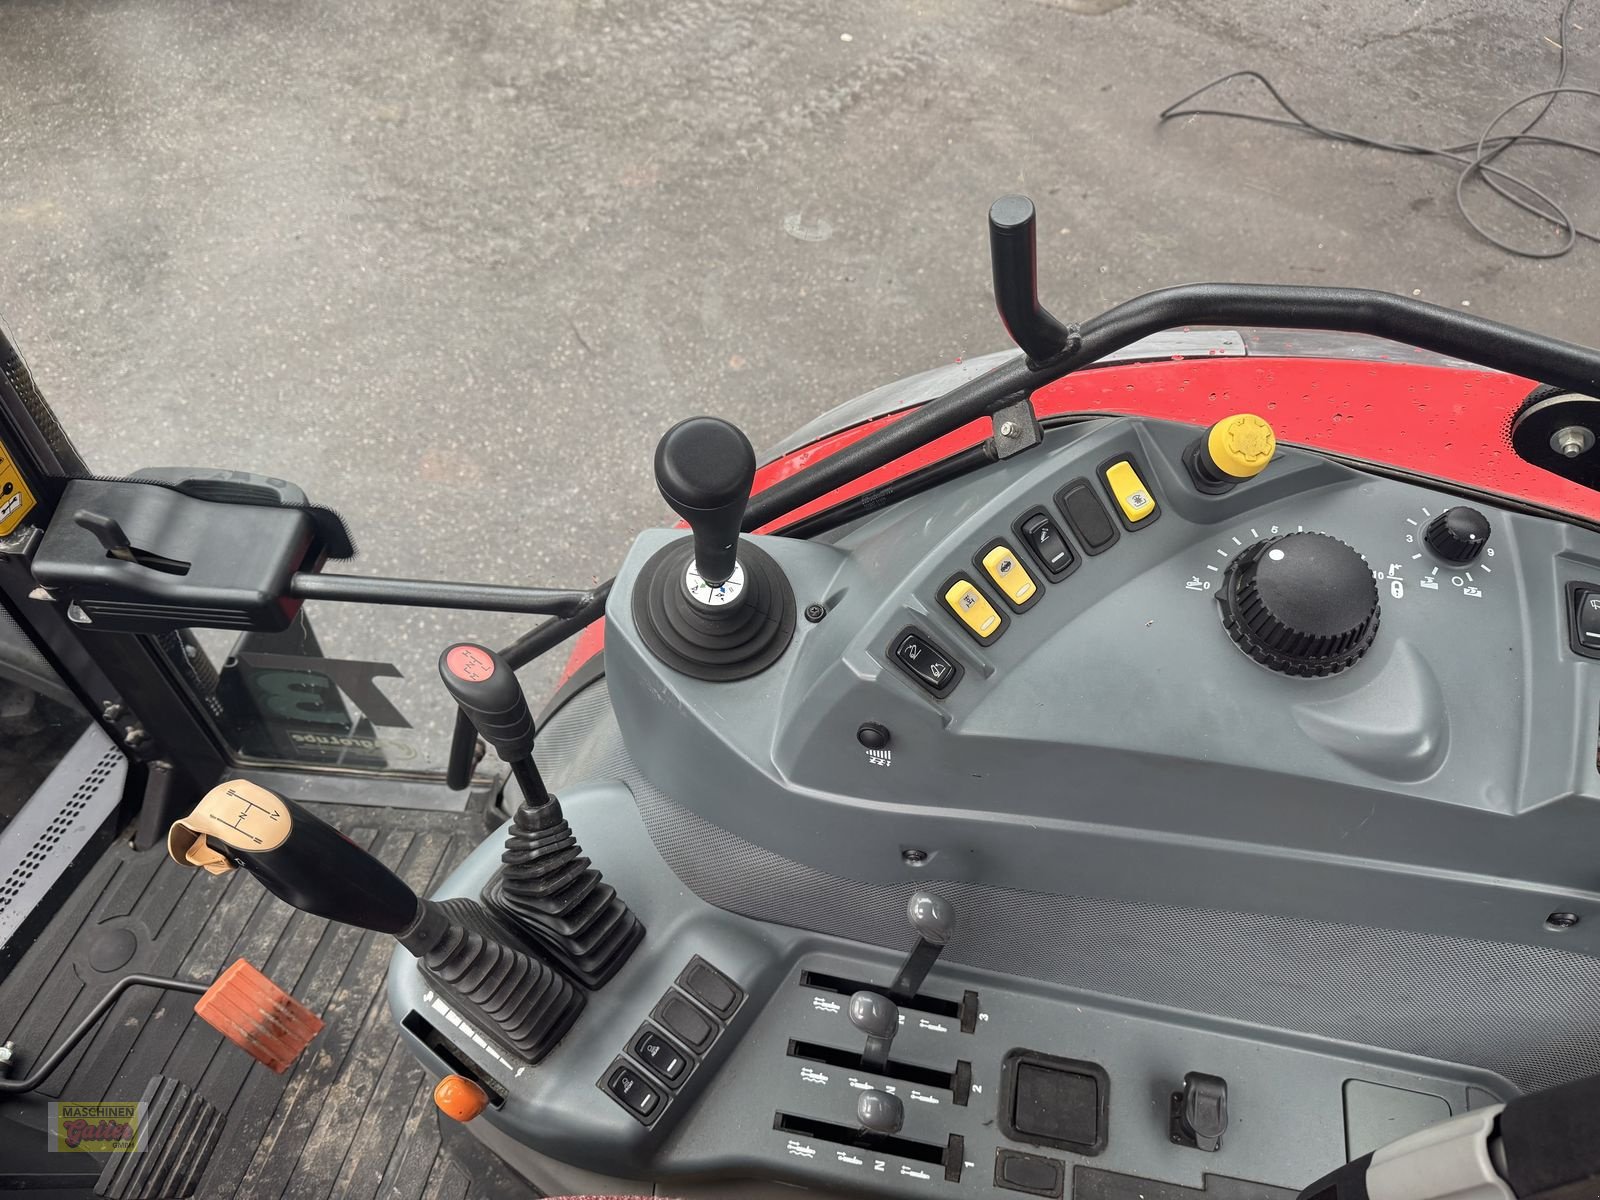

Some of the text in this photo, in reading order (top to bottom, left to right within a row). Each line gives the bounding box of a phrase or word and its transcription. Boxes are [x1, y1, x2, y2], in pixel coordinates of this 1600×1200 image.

[1270, 525, 1280, 534] 5
[1405, 534, 1414, 543] 3
[1486, 548, 1495, 557] 9
[1372, 570, 1385, 581] 10
[1202, 581, 1211, 590] 0
[978, 1012, 990, 1022] 3
[885, 1085, 897, 1096] N
[972, 1084, 983, 1094] 2
[874, 1159, 886, 1172] N
[964, 1160, 975, 1169] 1
